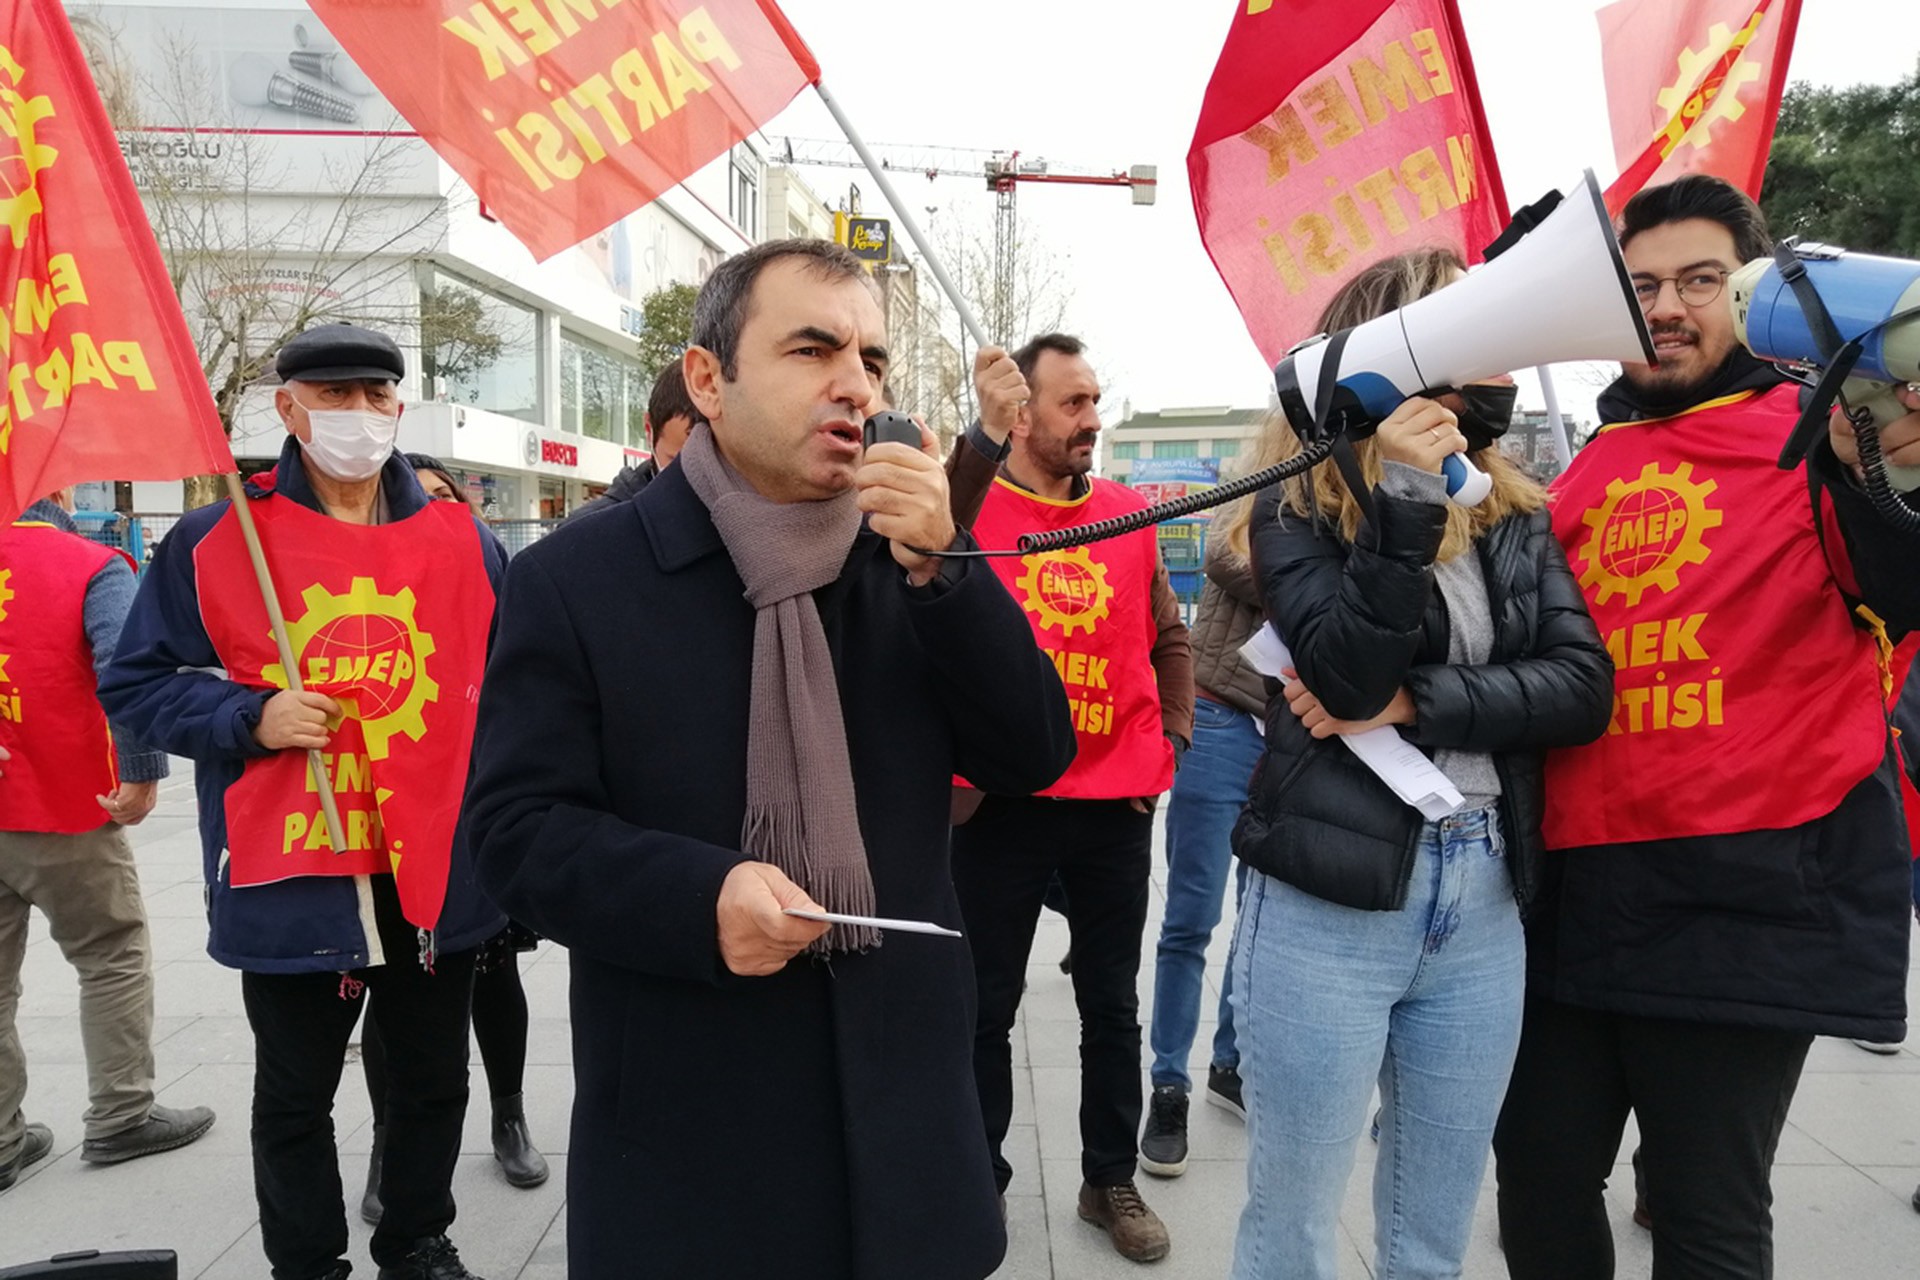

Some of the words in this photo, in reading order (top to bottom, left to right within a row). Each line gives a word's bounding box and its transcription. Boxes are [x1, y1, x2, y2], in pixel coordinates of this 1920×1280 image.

[541, 439, 578, 467] BOSCH
[1603, 510, 1687, 556] EMEP
[1042, 571, 1098, 600] EMEP
[304, 649, 413, 689] EMEP
